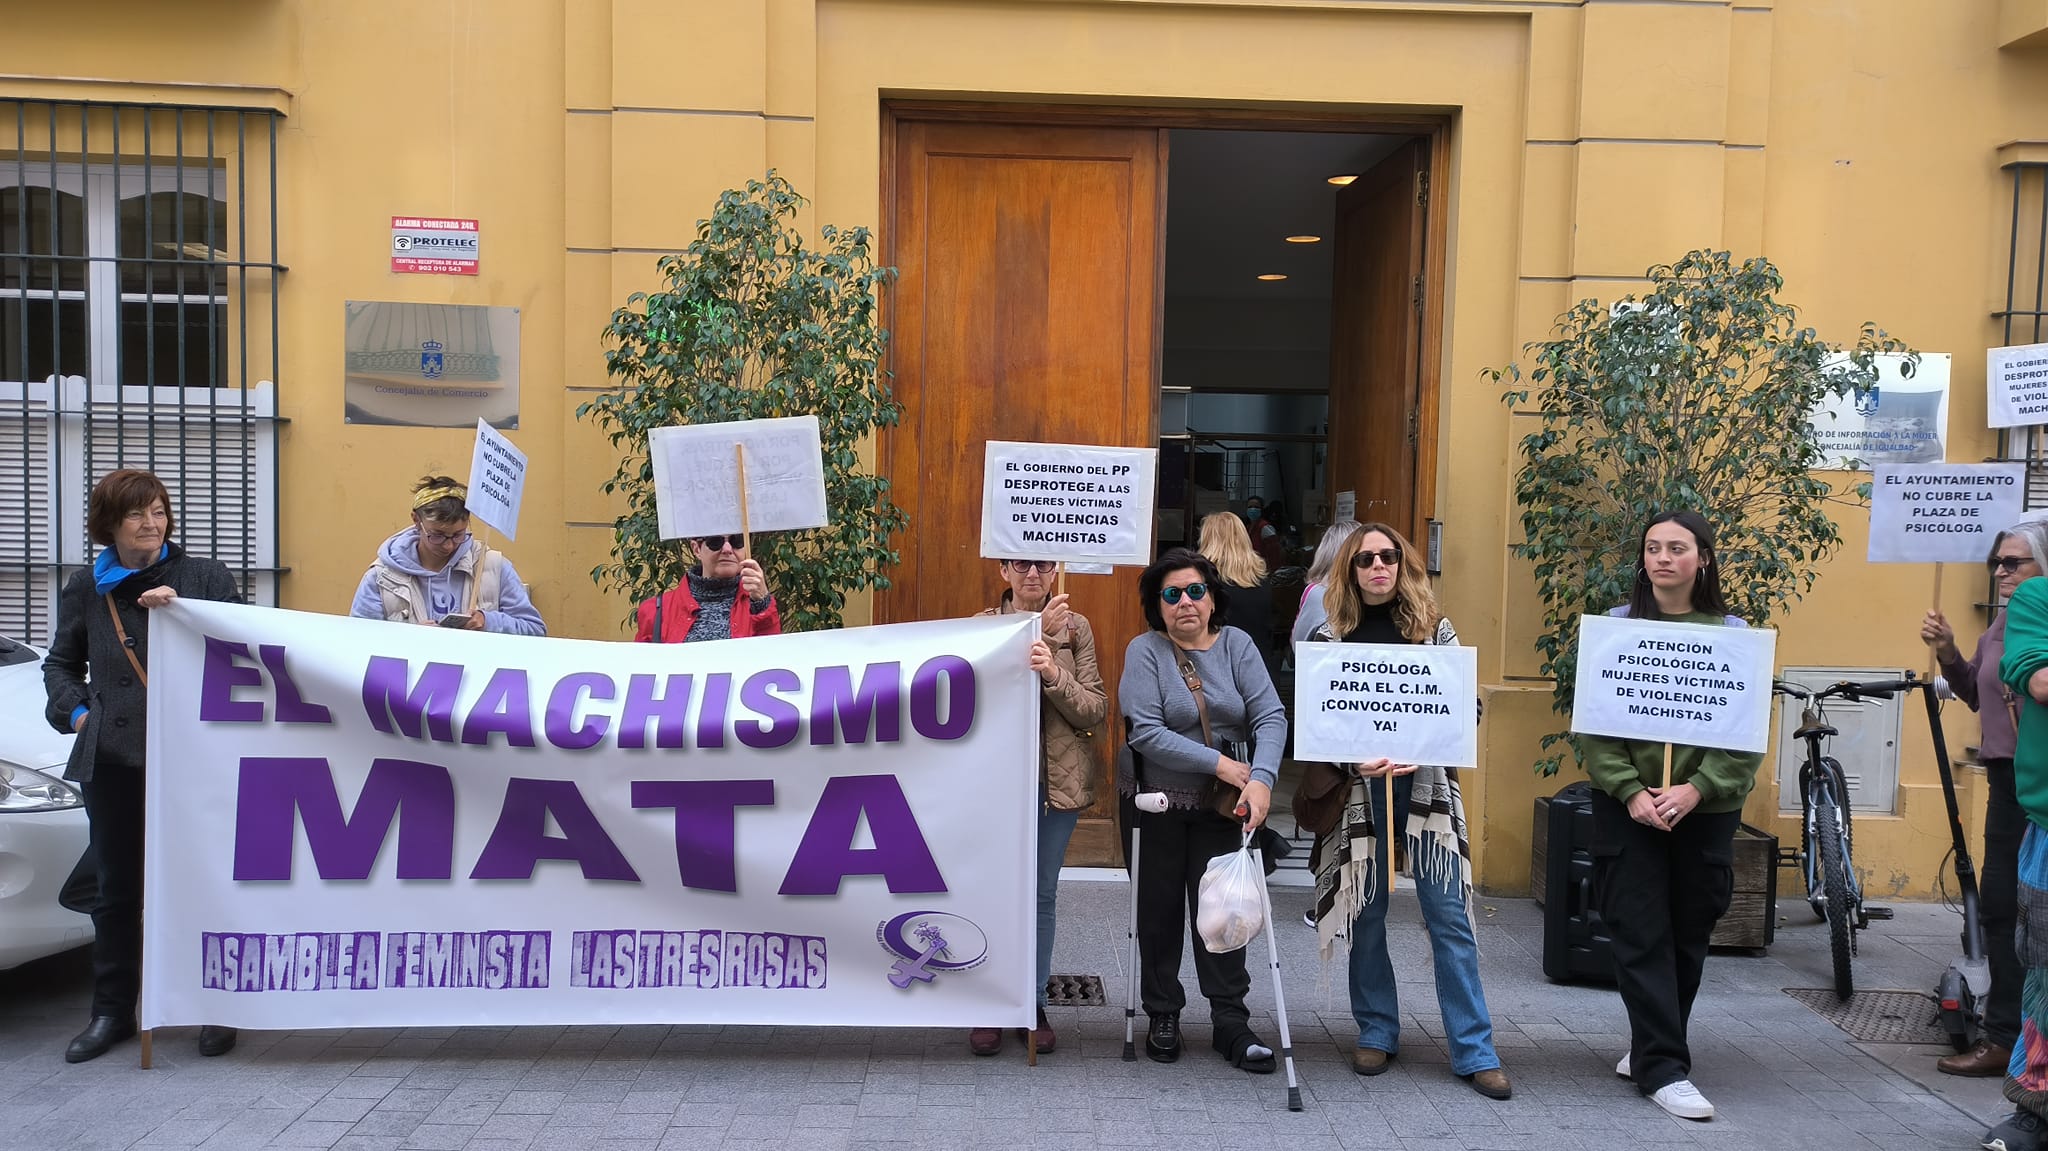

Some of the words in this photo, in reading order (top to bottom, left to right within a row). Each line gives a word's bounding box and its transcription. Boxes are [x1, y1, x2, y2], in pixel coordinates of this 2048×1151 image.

[395, 219, 420, 227] ALARMA
[423, 220, 459, 229] CONECTADA
[413, 238, 476, 246] PROTELEC
[427, 387, 439, 396] de
[442, 388, 489, 398] Comercio
[2009, 381, 2048, 391] MUJERES
[1912, 432, 1938, 440] MUJER
[481, 432, 486, 442] EL
[486, 437, 525, 472] AYUNTAMIENTO
[1862, 443, 1873, 451] DE
[483, 451, 493, 463] NO
[492, 457, 511, 476] CUBRE
[510, 471, 517, 482] LA
[1005, 462, 1020, 472] EL
[1023, 463, 1084, 474] GOBIERNO
[1087, 466, 1109, 476] DEL
[1111, 465, 1131, 476] PP
[486, 469, 504, 488] PLAZA
[504, 481, 511, 493] DE
[1004, 478, 1095, 493] DESPROTEGE
[1097, 484, 1106, 493] A
[1108, 485, 1131, 494] LAS
[1884, 475, 1902, 485] EL
[1905, 475, 2015, 486] AYUNTAMIENTO
[1010, 495, 1065, 507] MUJERES
[1067, 497, 1123, 509] VÍCTIMAS
[1902, 491, 1921, 501] NO
[1925, 491, 1971, 502] CUBRE
[1976, 492, 1993, 501] LA
[1012, 513, 1028, 523] DE
[1030, 512, 1119, 526] VIOLENCIAS
[1912, 507, 1956, 517] PLAZA
[1960, 508, 1979, 517] DE
[1904, 521, 1984, 534] PSICÓLOGA
[1022, 530, 1107, 544] MACHISTAS
[1637, 639, 1713, 655] ATENCIÓN
[1341, 660, 1431, 676] PSICÓLOGA
[1618, 654, 1717, 672] PSICOLÓGICA
[1720, 663, 1731, 673] A
[1601, 669, 1670, 685] MUJERES
[1674, 674, 1745, 691] VÍCTIMAS
[200, 635, 333, 723] EL
[362, 654, 977, 750] MACHISMO
[1330, 680, 1370, 693] PARA
[1375, 682, 1394, 693] EL
[1399, 683, 1443, 695] C.I.M.
[1616, 687, 1635, 697] DE
[1639, 688, 1728, 706] VIOLENCIAS
[1321, 699, 1450, 715] ¡CONVOCATORIA
[1628, 704, 1713, 722] MACHISTAS
[1373, 720, 1398, 731] YA!
[232, 757, 948, 896] MATA
[202, 931, 381, 992] ASAMBLEA
[723, 931, 827, 989] ROSAS
